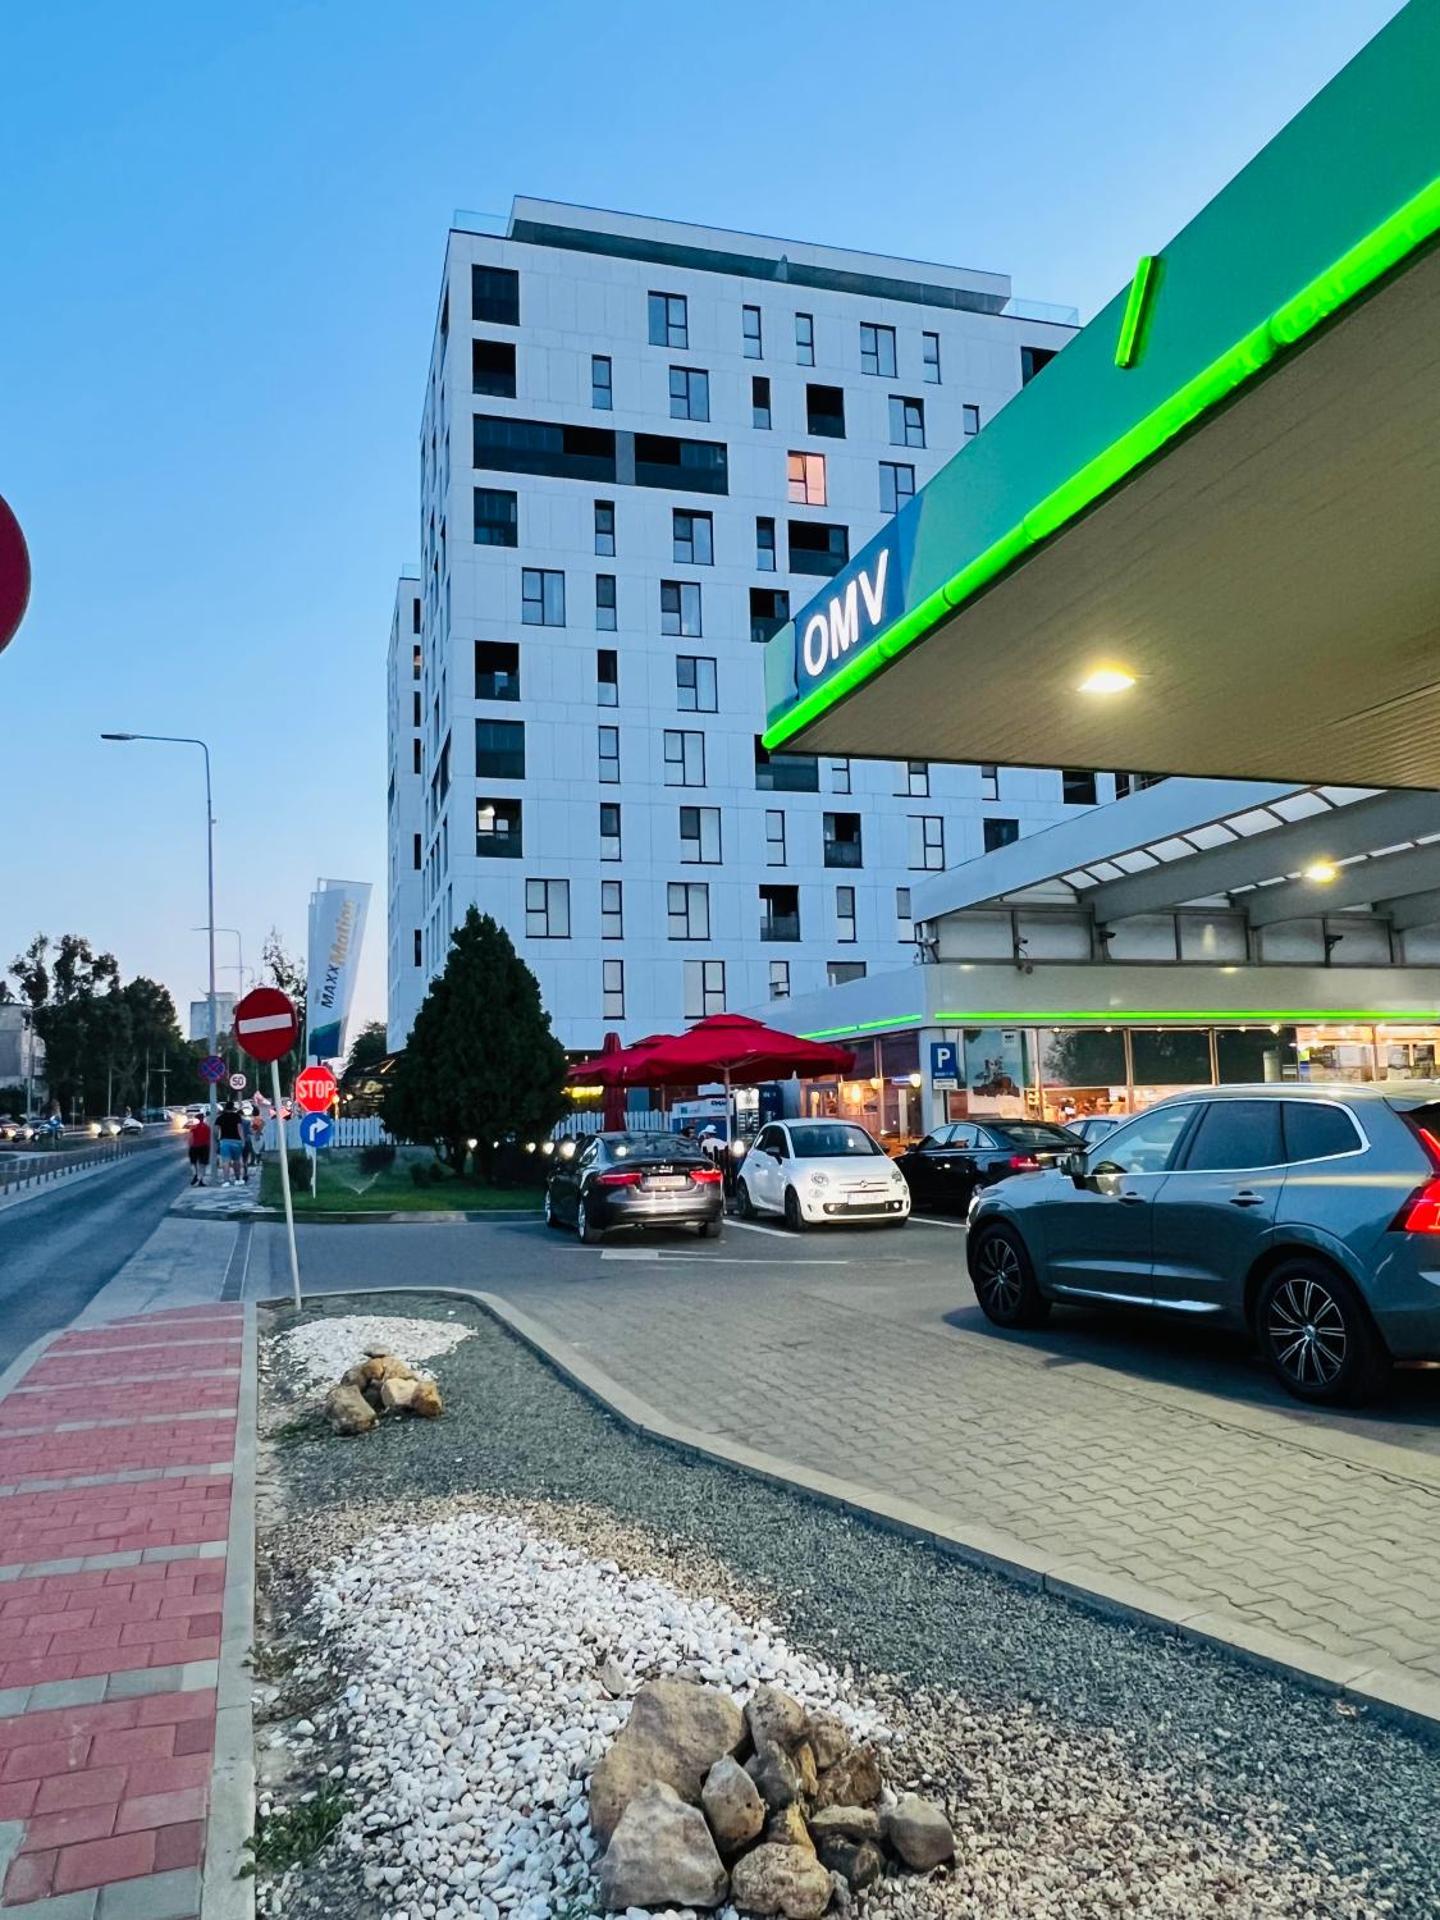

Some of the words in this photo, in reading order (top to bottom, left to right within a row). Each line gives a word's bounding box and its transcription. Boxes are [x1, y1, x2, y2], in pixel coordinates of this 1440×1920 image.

[803, 549, 889, 677] OMV
[320, 964, 340, 1009] MAXX
[937, 1048, 950, 1068] P
[232, 1076, 244, 1087] 50
[298, 1080, 335, 1099] STOP
